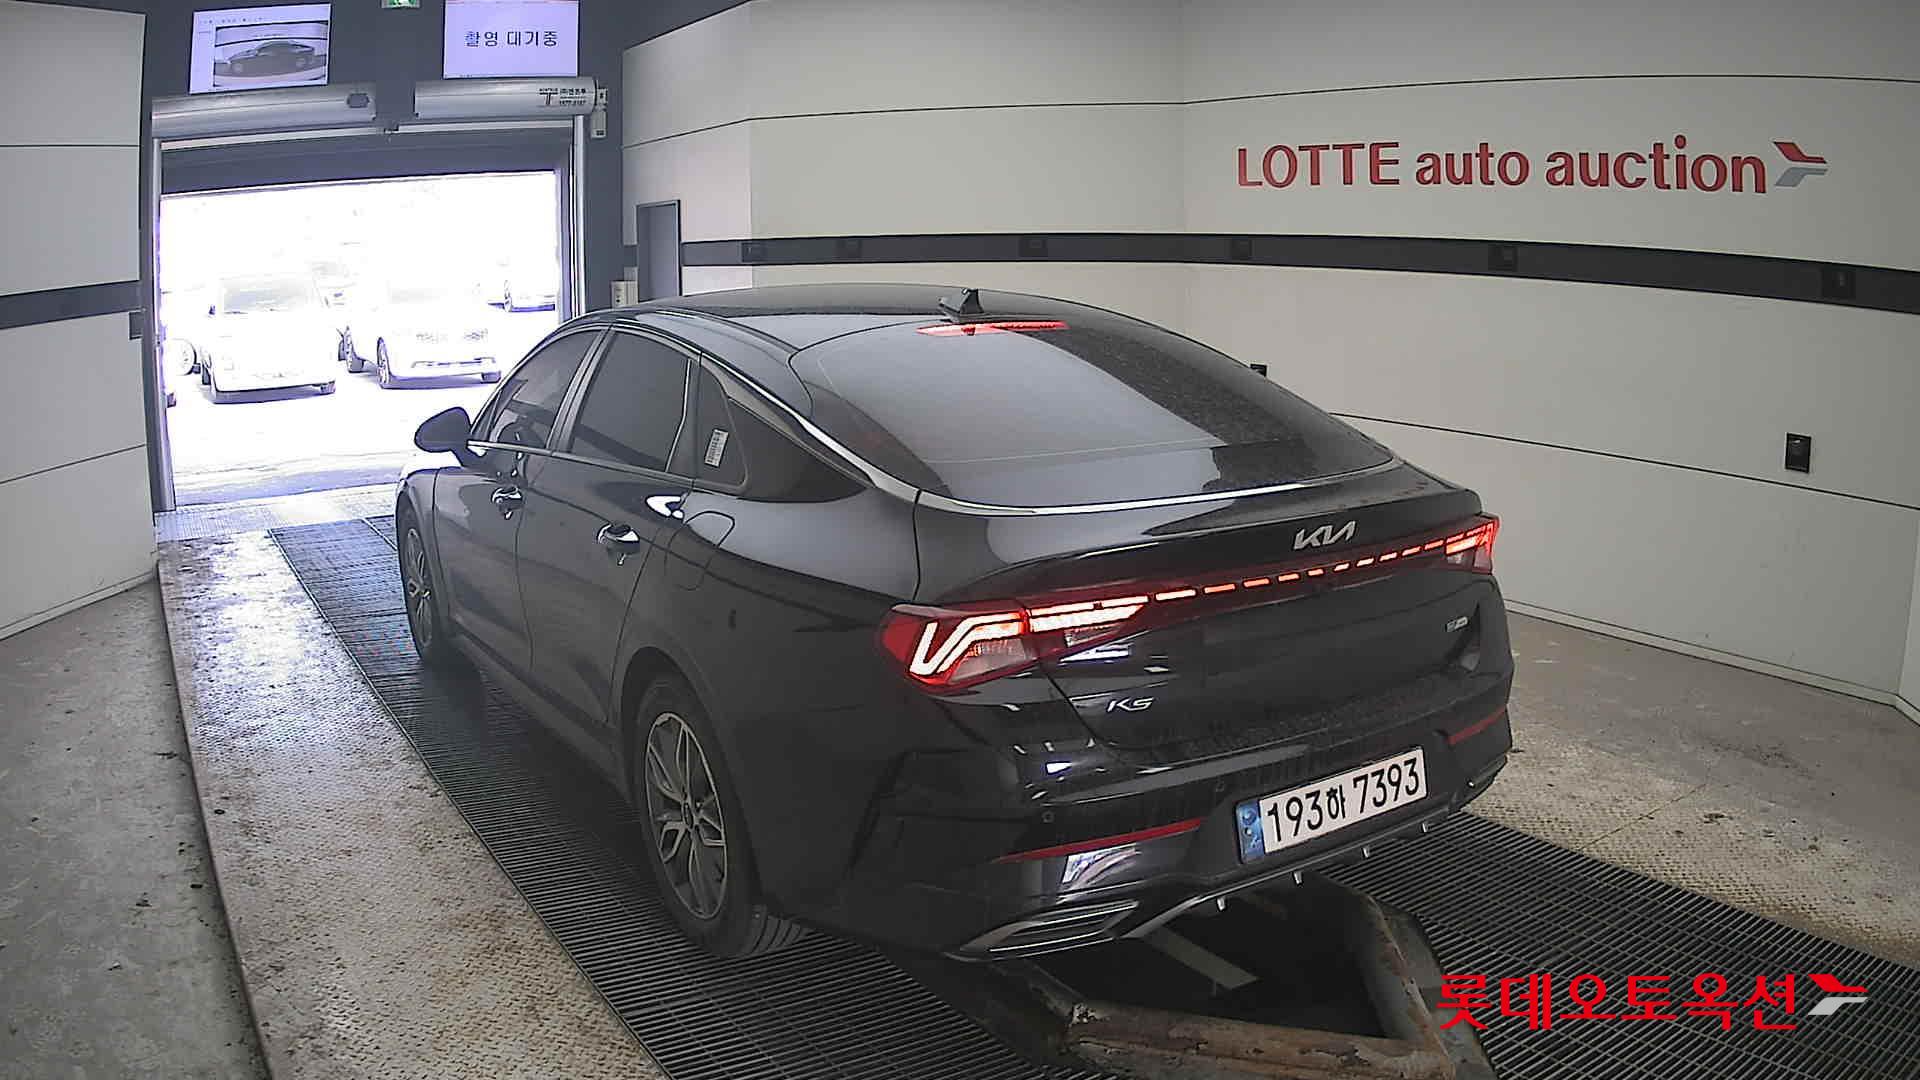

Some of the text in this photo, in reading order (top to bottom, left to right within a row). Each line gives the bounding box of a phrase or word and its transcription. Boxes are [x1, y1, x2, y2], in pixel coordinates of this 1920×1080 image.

[1238, 134, 1767, 193] LOTTE auto auction
